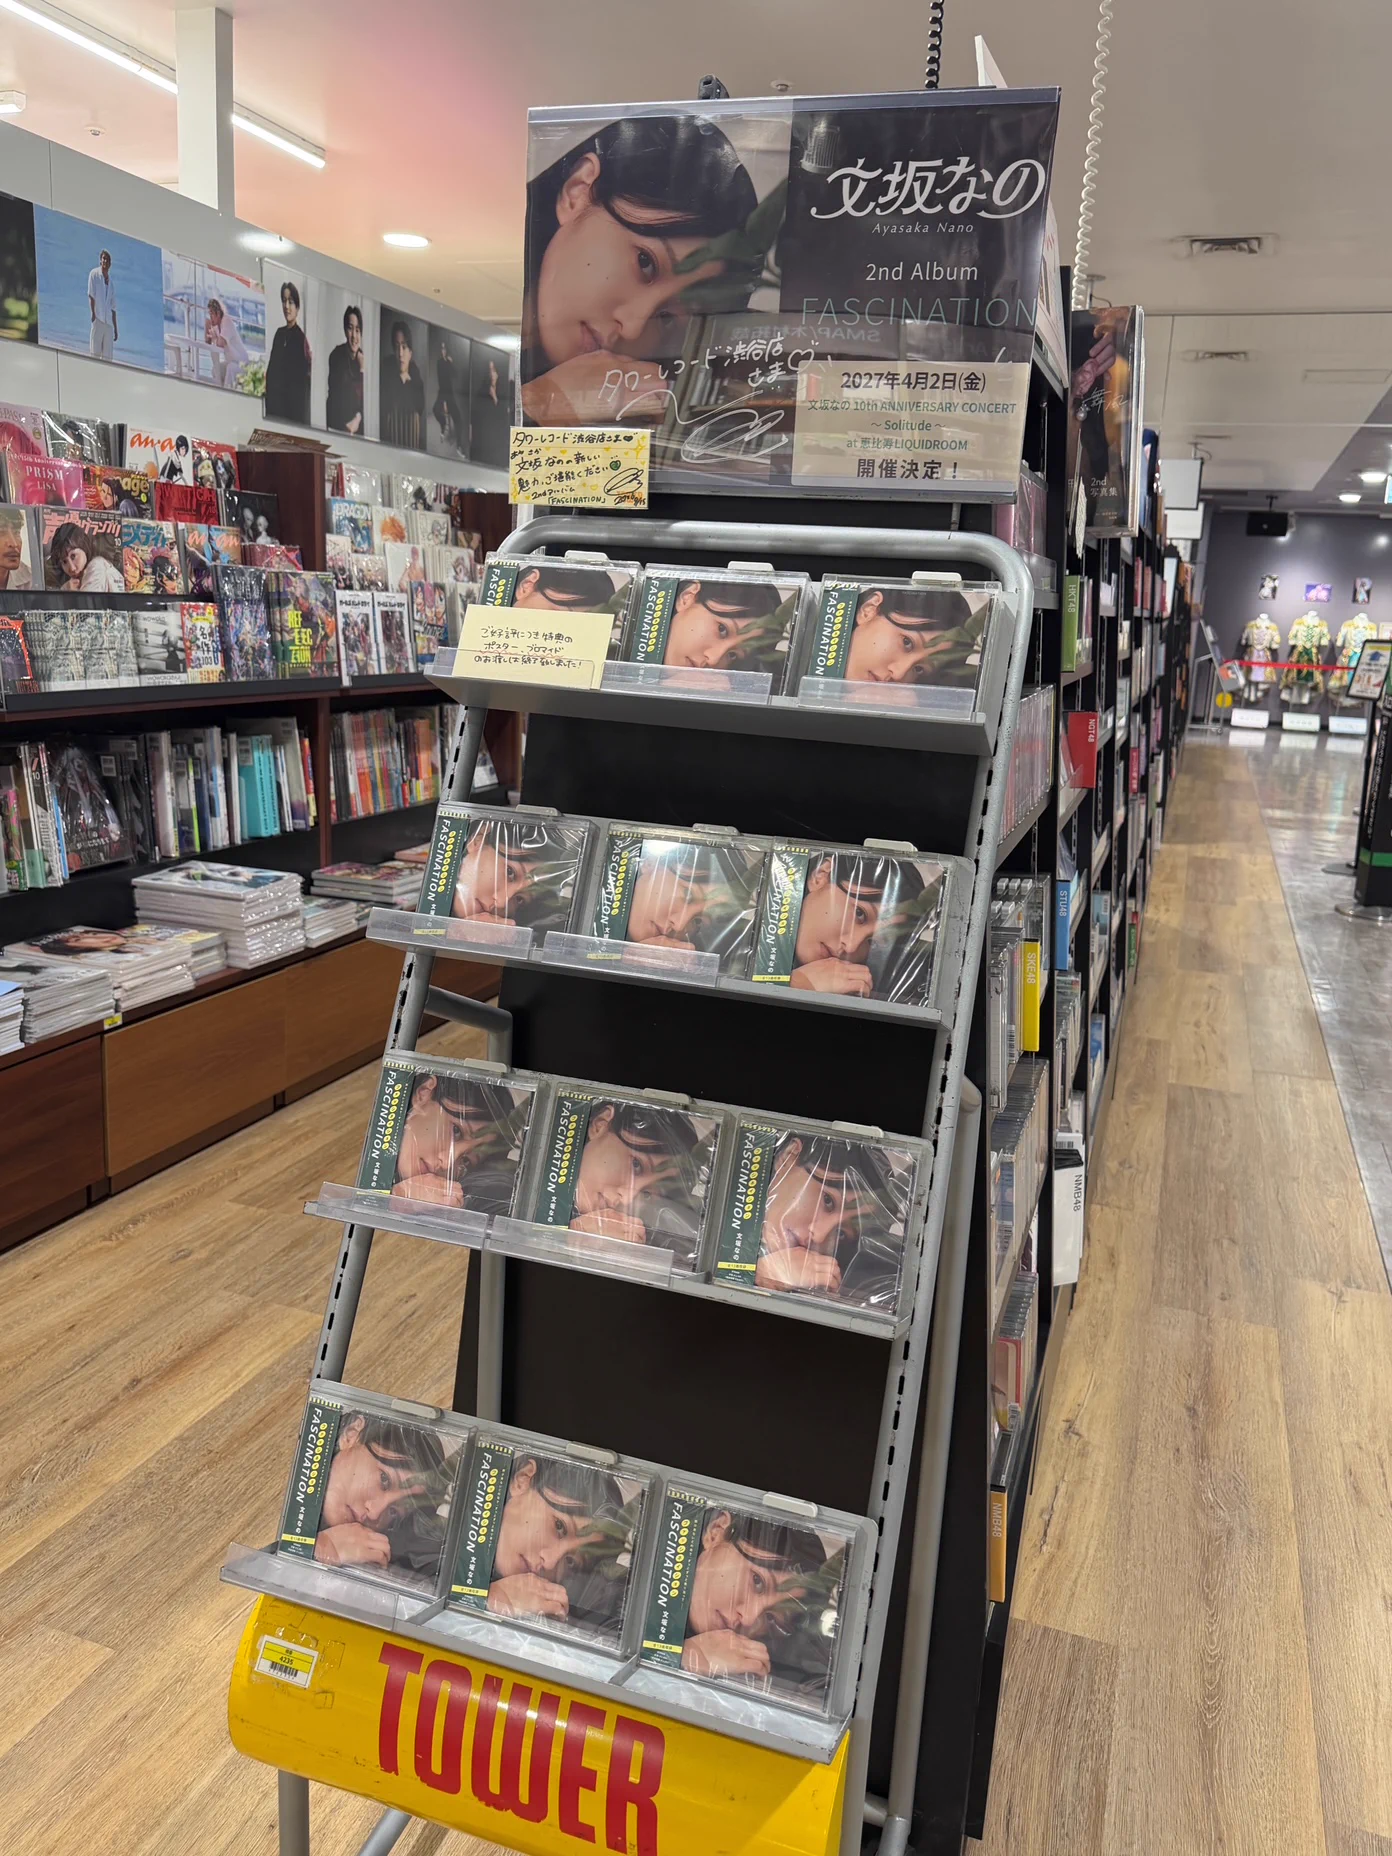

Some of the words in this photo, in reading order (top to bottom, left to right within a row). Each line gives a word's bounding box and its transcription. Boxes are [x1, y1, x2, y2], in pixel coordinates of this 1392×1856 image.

[810, 156, 1046, 221] 文坂なの
[871, 222, 930, 236] Ayasaka
[936, 222, 975, 235] Nano
[865, 262, 906, 282] 2nd
[910, 262, 979, 281] Album
[800, 296, 1037, 327] FASCINATION
[840, 371, 987, 393] 2027年4月2日(金)
[807, 399, 850, 411] 文坂なの
[853, 399, 878, 411] 10th
[880, 401, 960, 413] ANNIVERSARY
[961, 402, 1017, 414] CONCERT
[884, 419, 932, 431] Solitude
[1090, 478, 1107, 487] 2nd
[1067, 584, 1077, 613] HKT48
[480, 626, 574, 644] ご好評につき特典の
[636, 579, 660, 661] FASCINATION
[815, 591, 839, 675] FASCINATION
[1087, 718, 1096, 743] NGT48
[427, 819, 451, 902] FASCINATION
[600, 839, 623, 925] FASCINATION
[1059, 890, 1068, 917] STU48
[1026, 952, 1037, 985] SKE48
[371, 1070, 397, 1160] FASCINATION
[546, 1101, 572, 1193] FASCINATION
[731, 1132, 756, 1230] FASCINATION
[1073, 1174, 1083, 1212] NMB48
[295, 1407, 322, 1504] FASCINATION
[465, 1452, 493, 1553] FASCINATION
[991, 1502, 1003, 1538] NMB48
[657, 1501, 684, 1608] FASCINATION
[279, 1655, 294, 1666] 4235
[378, 1641, 666, 1856] TOWER
